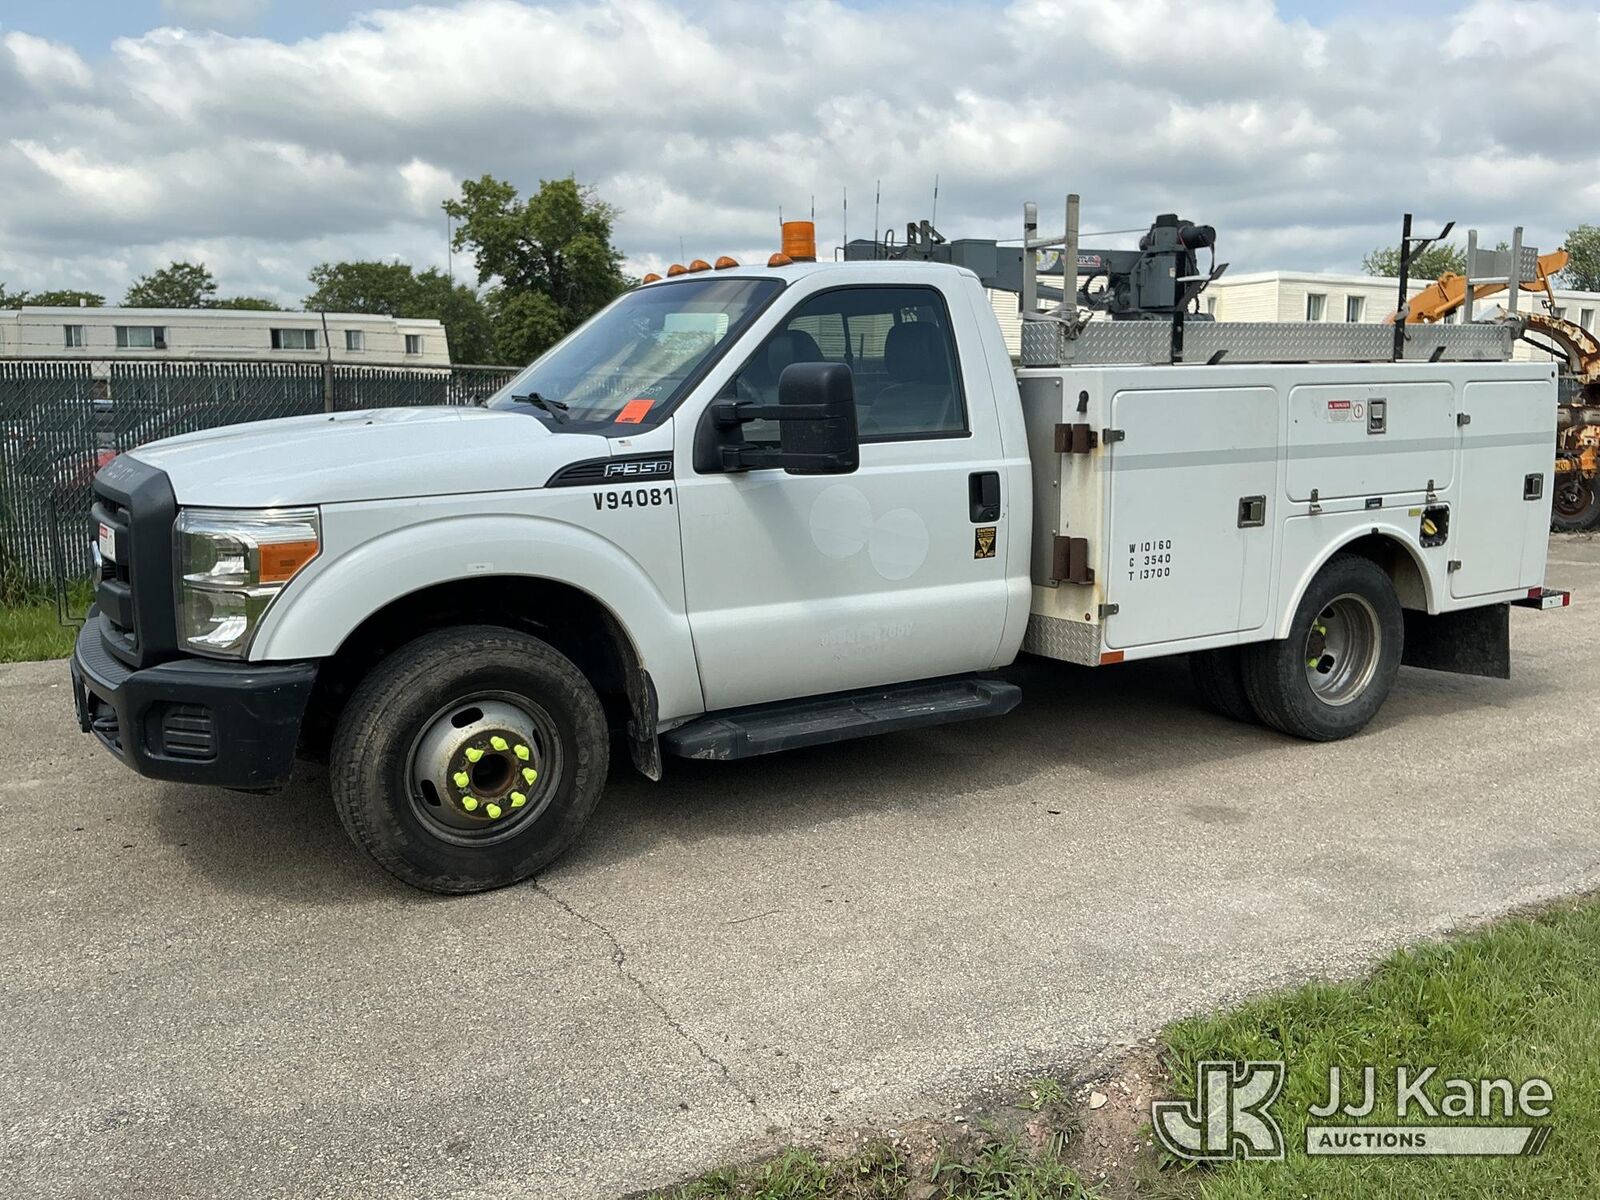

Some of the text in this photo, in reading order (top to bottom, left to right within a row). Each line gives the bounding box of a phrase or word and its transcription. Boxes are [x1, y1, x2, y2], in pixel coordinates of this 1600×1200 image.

[593, 487, 674, 511] V94081
[1129, 540, 1171, 553] W 10160
[1144, 553, 1171, 565] 3540
[1128, 567, 1170, 581] T 13700
